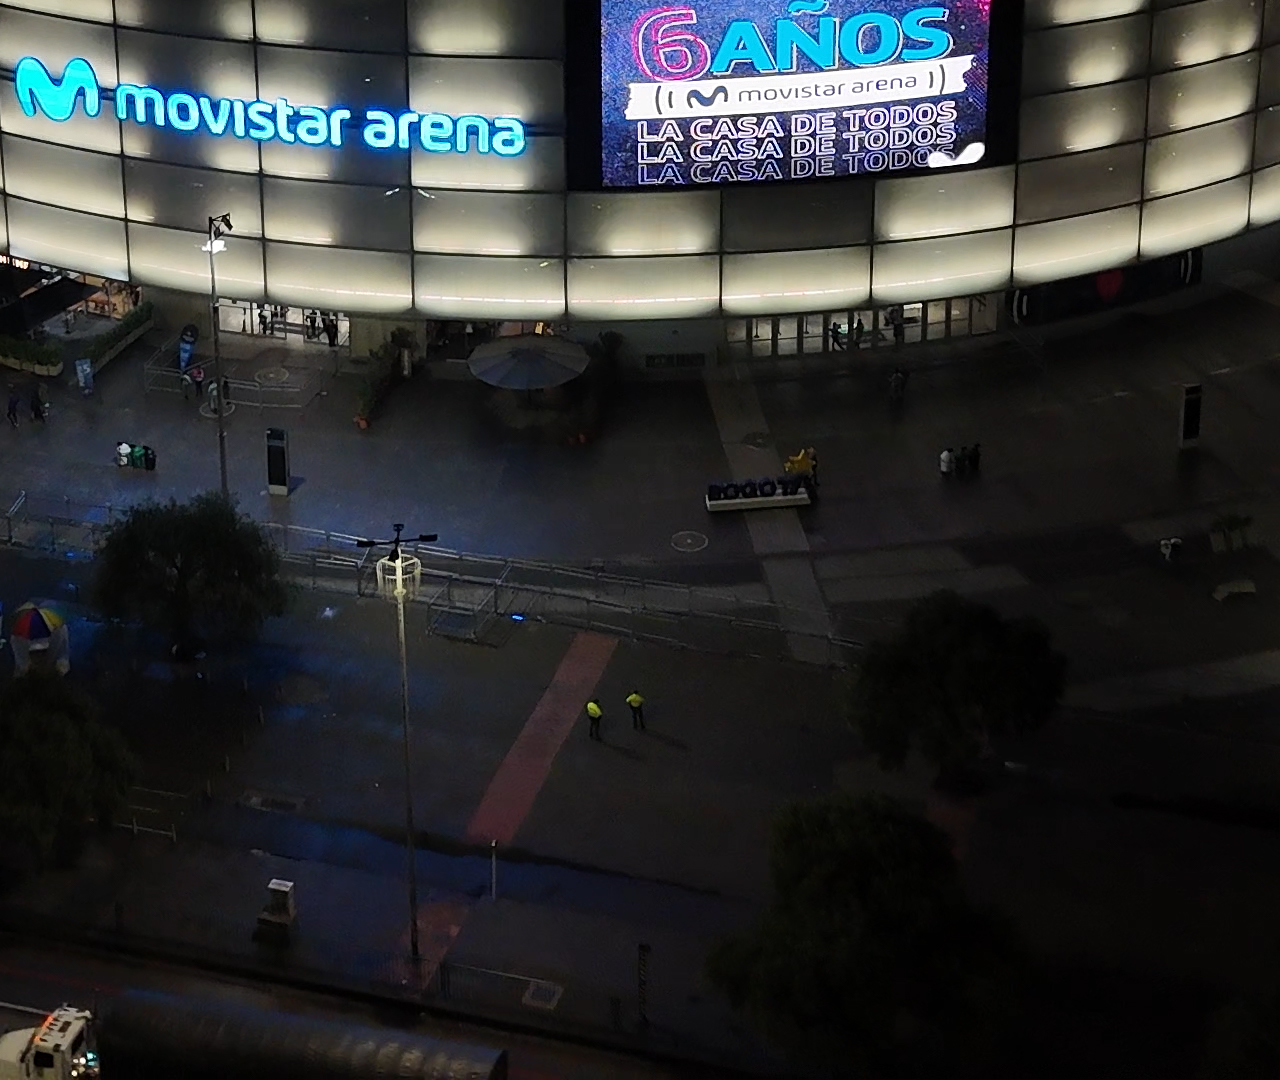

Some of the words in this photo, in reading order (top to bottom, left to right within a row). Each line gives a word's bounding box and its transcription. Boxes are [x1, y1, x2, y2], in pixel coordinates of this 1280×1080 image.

[631, 5, 711, 82] 6
[710, 0, 954, 75] AÑOS
[738, 83, 846, 102] movistar
[852, 73, 917, 94] arena
[115, 83, 350, 147] movistar
[361, 109, 526, 157] arena
[637, 120, 684, 142] LA
[690, 116, 785, 140] CASA
[791, 112, 837, 136] DE
[843, 101, 958, 132] TODOS
[637, 142, 684, 163] LA
[690, 137, 784, 162] CASA
[791, 133, 836, 157] DE
[843, 122, 957, 153] TODOS
[638, 163, 685, 185] LA
[691, 159, 783, 183] CASA
[791, 156, 835, 179] DE
